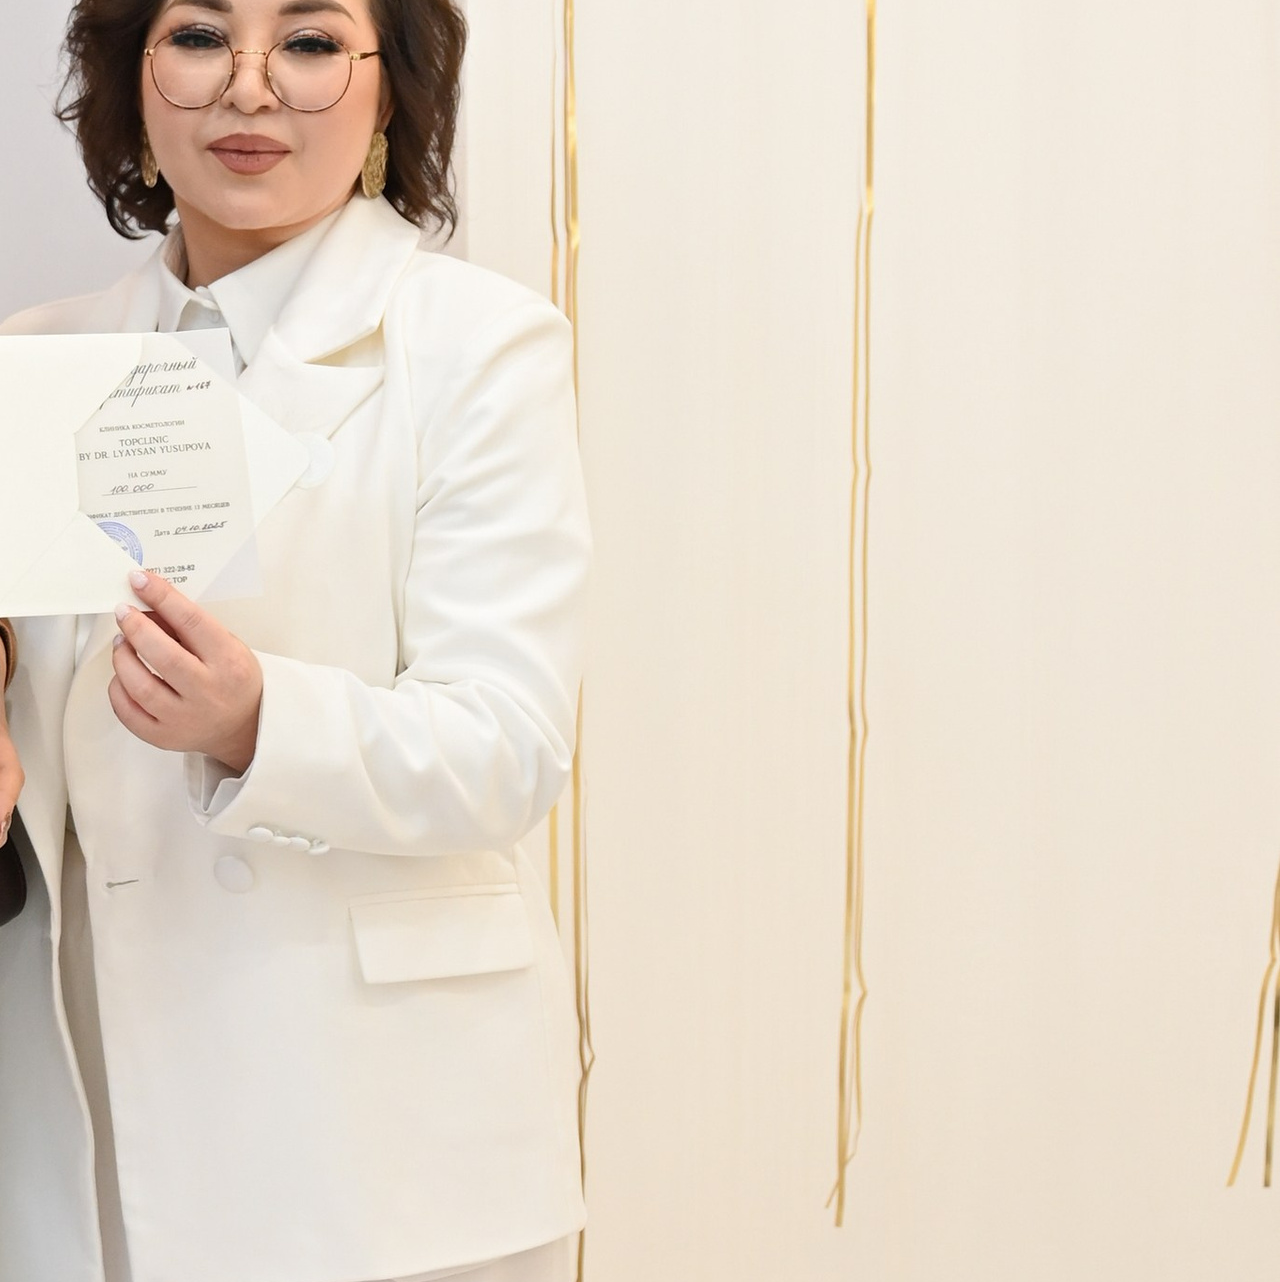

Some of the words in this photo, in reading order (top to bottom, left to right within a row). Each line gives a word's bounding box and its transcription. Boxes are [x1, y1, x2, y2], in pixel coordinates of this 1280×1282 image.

[119, 435, 169, 447] TOPCLINIC
[79, 452, 91, 461] BY
[113, 446, 157, 458] LYAYSAN
[160, 442, 211, 454] YUSUPOVA
[128, 471, 138, 479] НА
[140, 469, 167, 478] СУММУ
[154, 529, 170, 537] Дата
